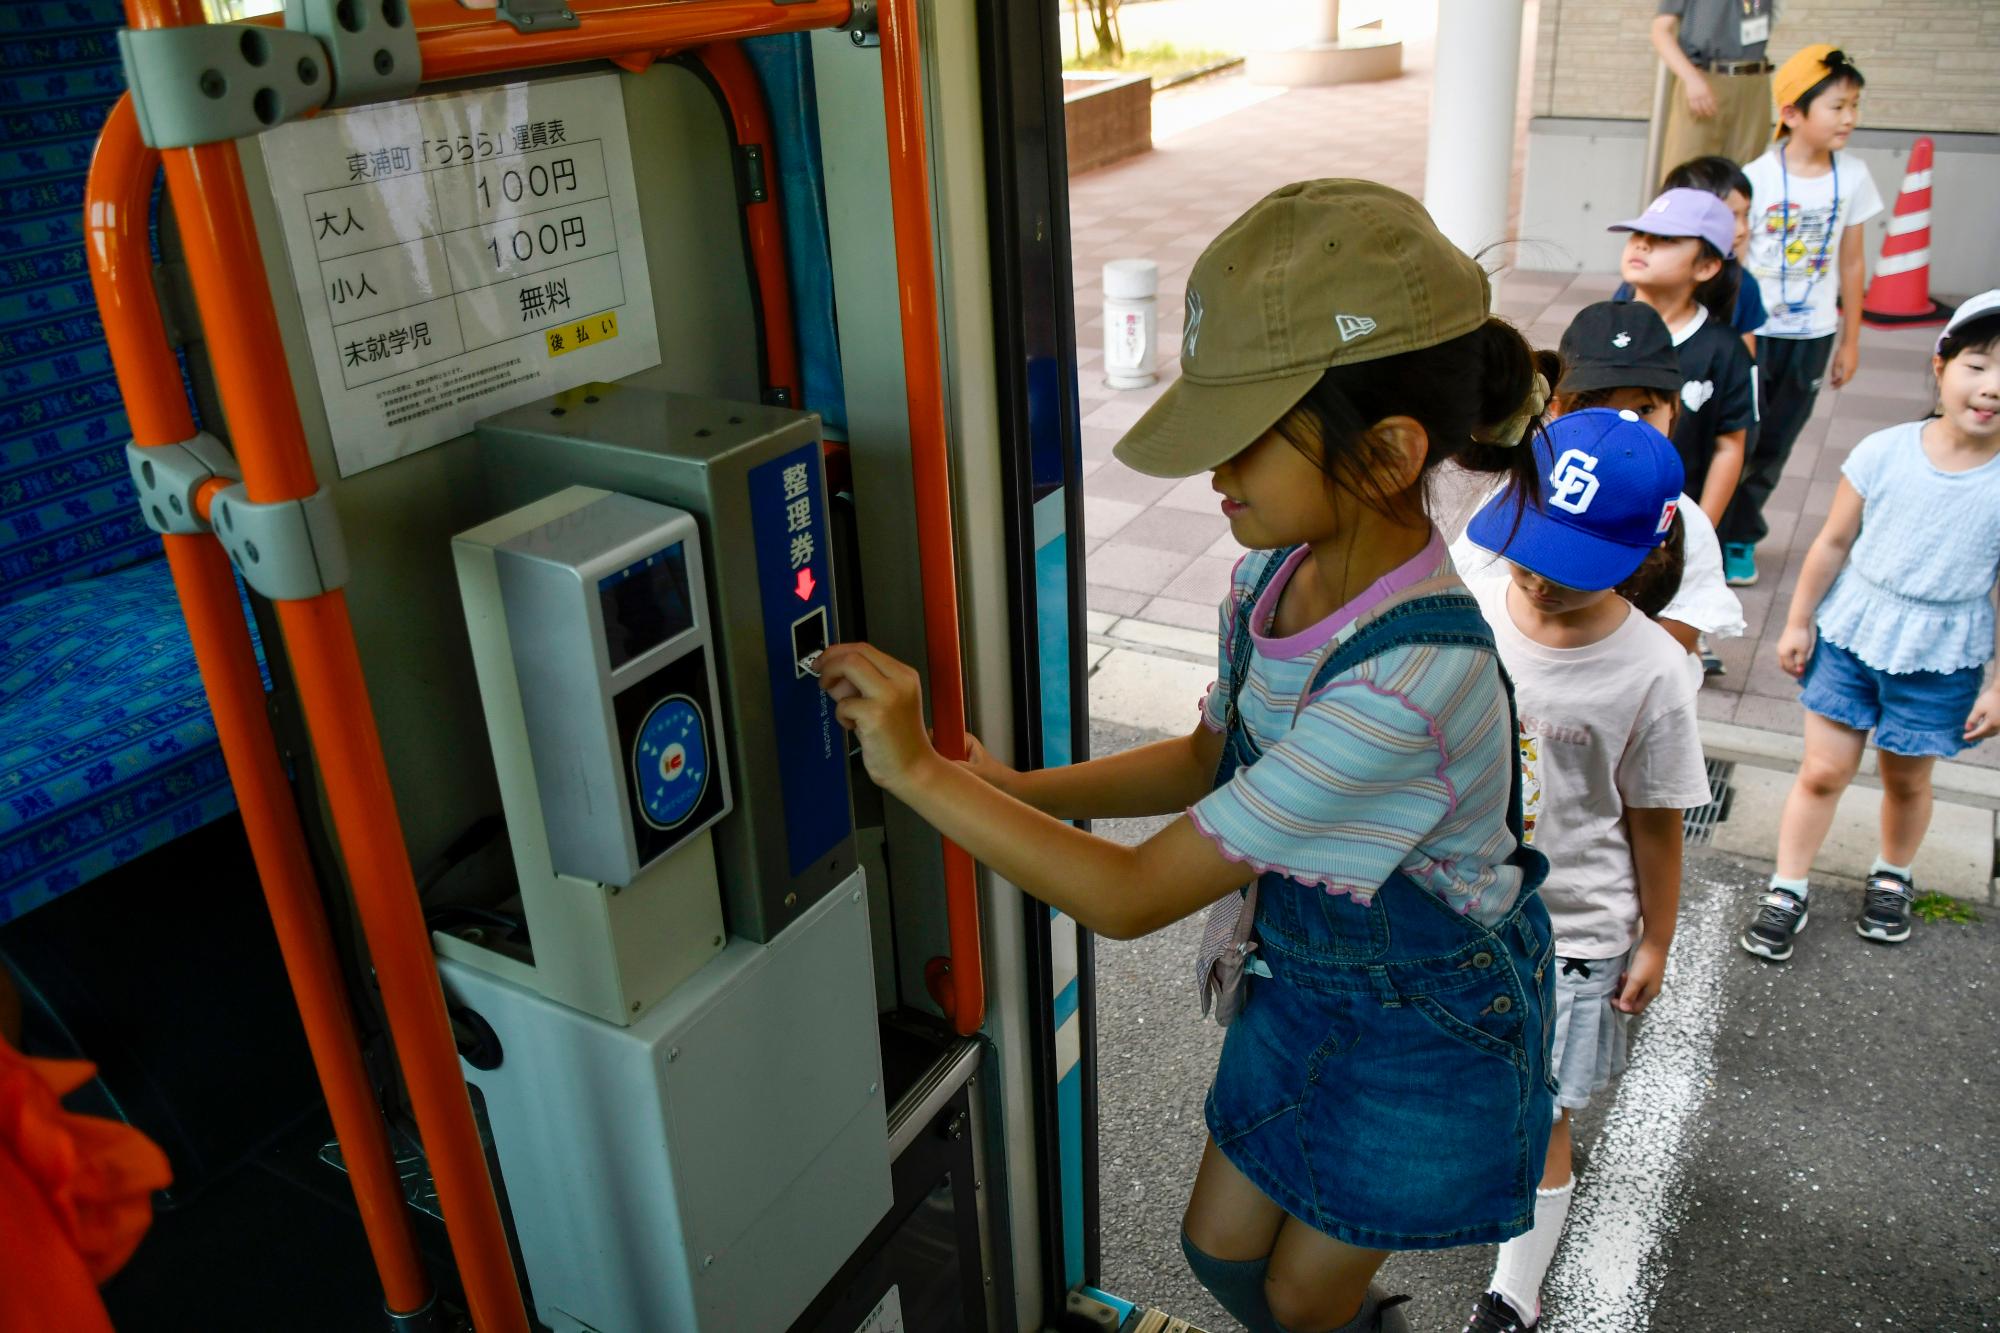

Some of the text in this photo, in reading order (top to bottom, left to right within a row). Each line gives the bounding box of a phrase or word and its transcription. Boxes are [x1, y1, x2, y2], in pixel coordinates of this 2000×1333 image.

[346, 119, 566, 181] 東浦町「うらら」運賃表
[478, 158, 577, 208] 100円
[315, 206, 364, 241] 大人
[487, 216, 586, 268] 100円
[331, 272, 377, 304] 小人
[519, 278, 571, 322] 無料
[344, 321, 432, 368] 未就学児
[550, 318, 614, 351] 後払い
[783, 463, 814, 569] 整理券
